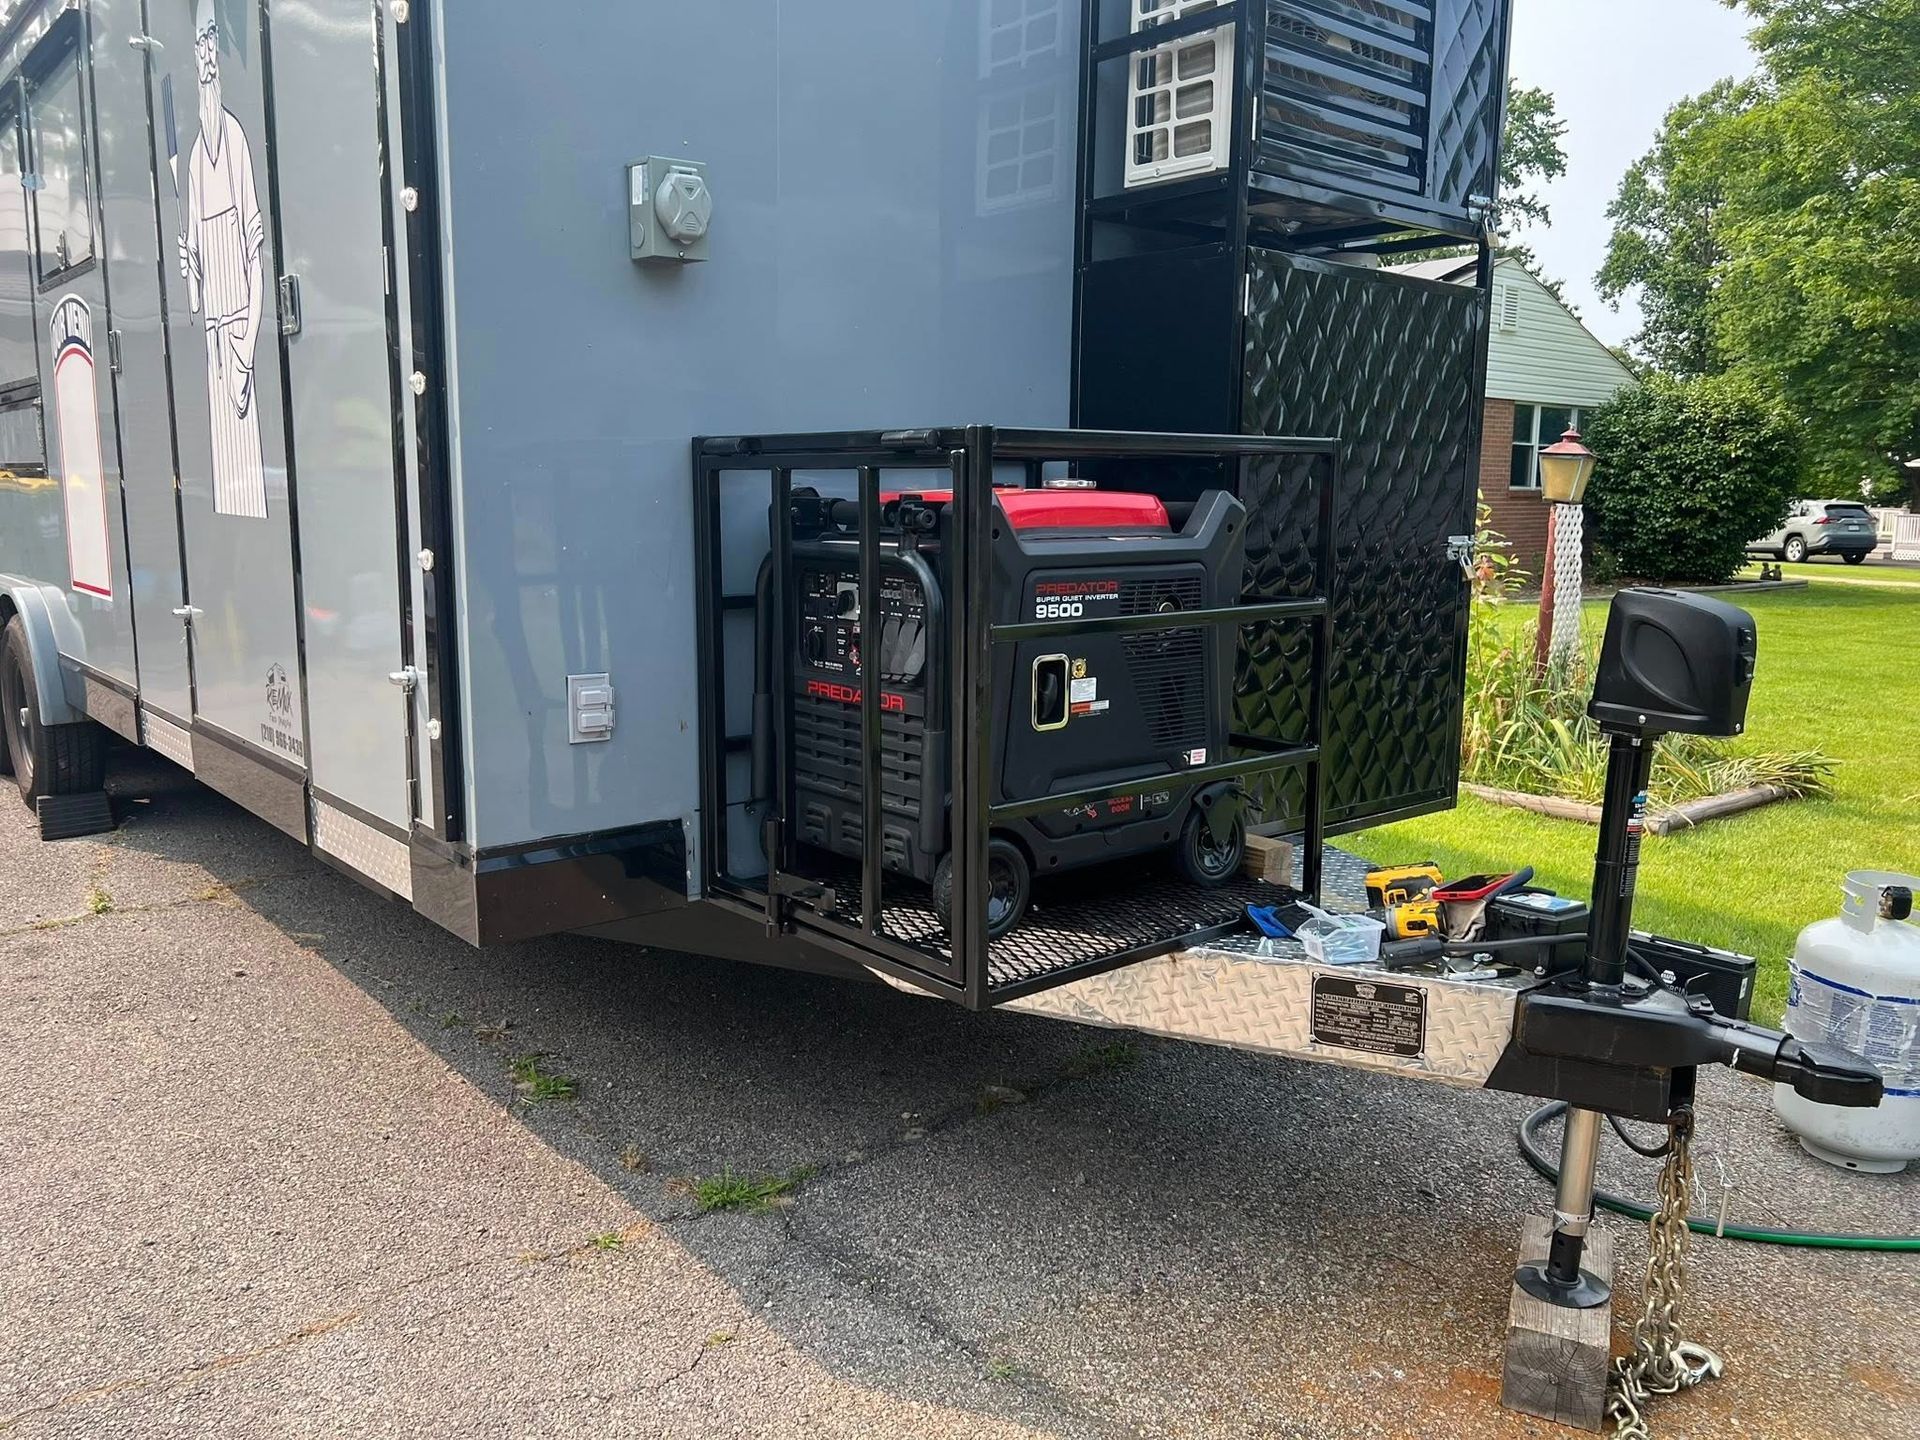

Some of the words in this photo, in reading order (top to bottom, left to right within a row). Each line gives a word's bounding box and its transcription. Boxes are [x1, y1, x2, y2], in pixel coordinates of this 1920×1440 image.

[1035, 581, 1118, 594] PREDATOR
[1085, 593, 1119, 601] INVERTER
[1035, 602, 1083, 619] 9500
[807, 680, 905, 711] PREDAOR
